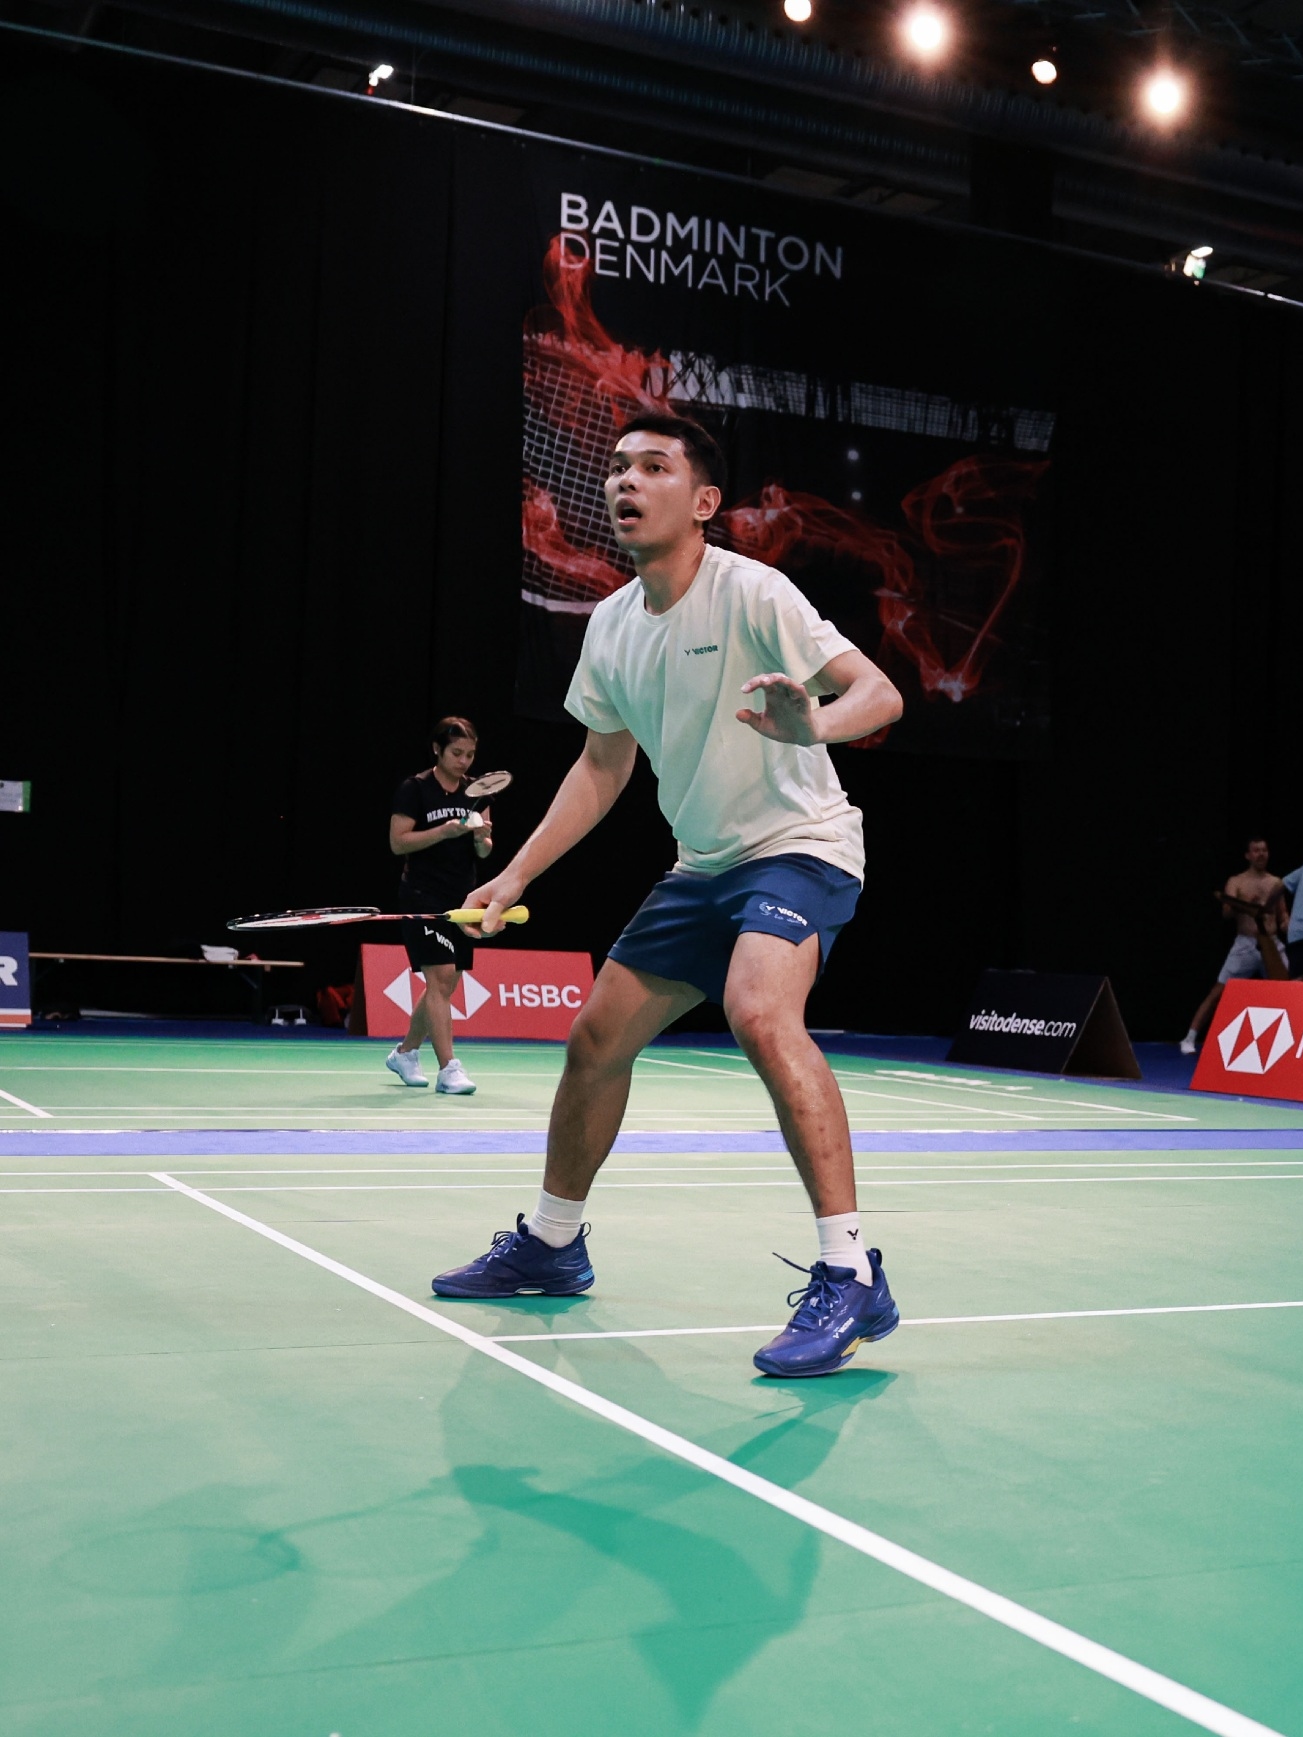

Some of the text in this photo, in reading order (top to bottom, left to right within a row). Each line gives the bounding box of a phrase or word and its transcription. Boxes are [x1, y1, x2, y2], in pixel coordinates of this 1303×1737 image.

[560, 192, 843, 280] BADMINTON
[559, 232, 791, 308] DENMARK
[692, 645, 719, 655] VICTOR
[426, 807, 456, 823] READY
[455, 807, 466, 818] TO
[776, 906, 808, 927] VICTOR
[498, 983, 582, 1009] HSBC
[969, 1009, 1077, 1038] visitodense.com
